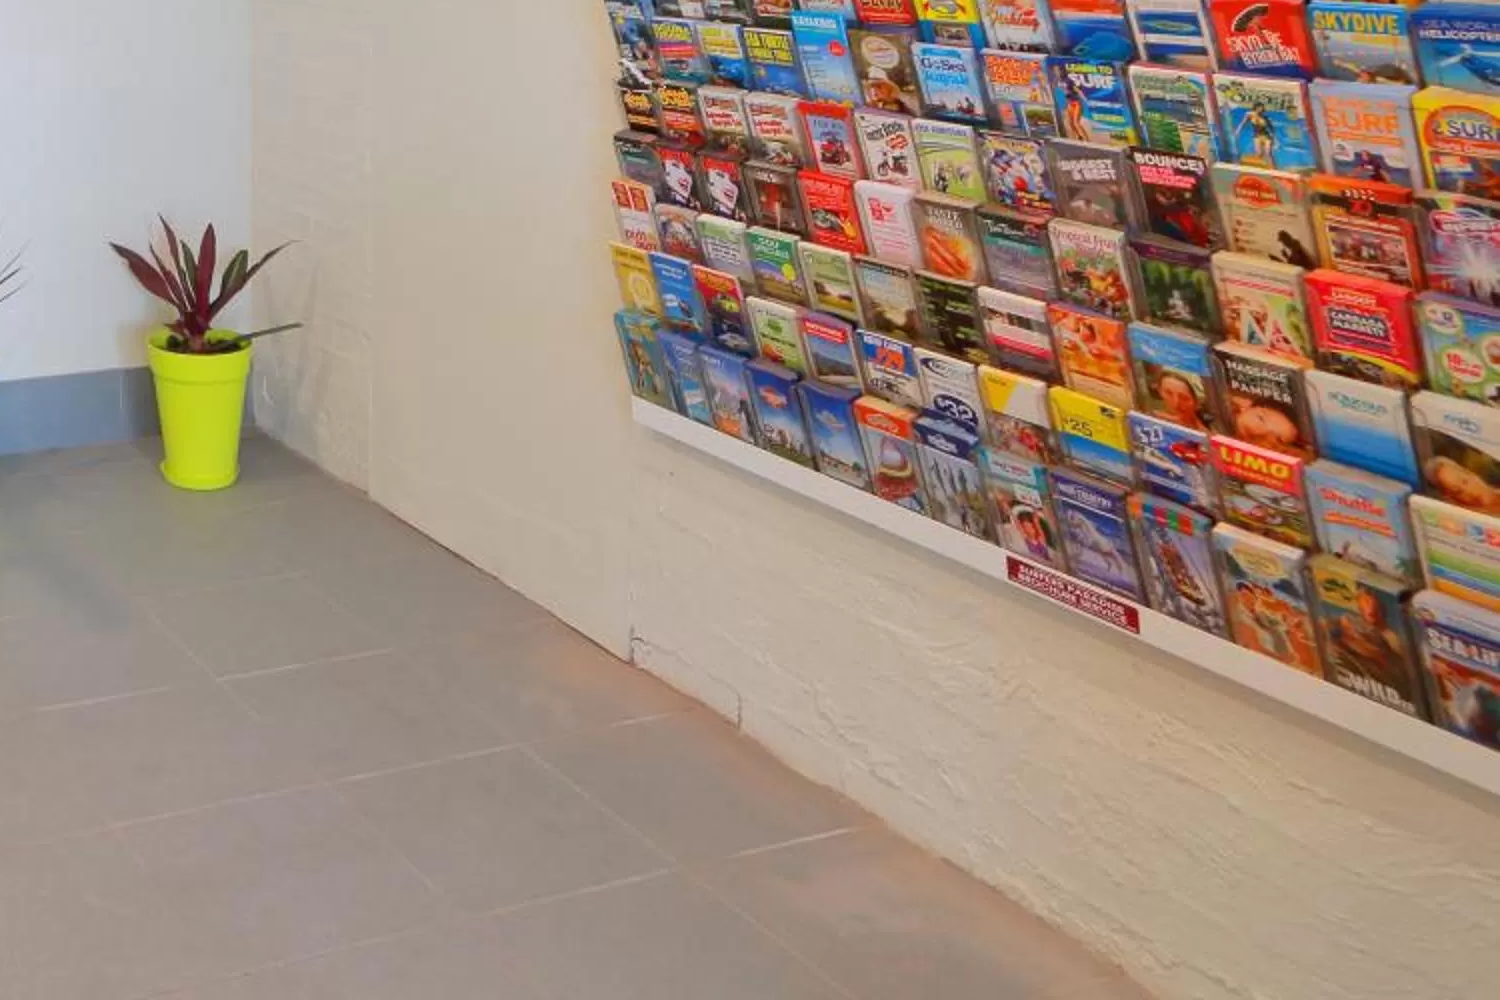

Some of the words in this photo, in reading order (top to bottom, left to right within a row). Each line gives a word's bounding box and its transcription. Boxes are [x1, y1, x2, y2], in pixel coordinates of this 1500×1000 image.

[1314, 10, 1399, 34] SKYDIVE
[1067, 73, 1117, 90] SURF
[1328, 111, 1399, 133] SURF
[1220, 445, 1292, 480] LIMO
